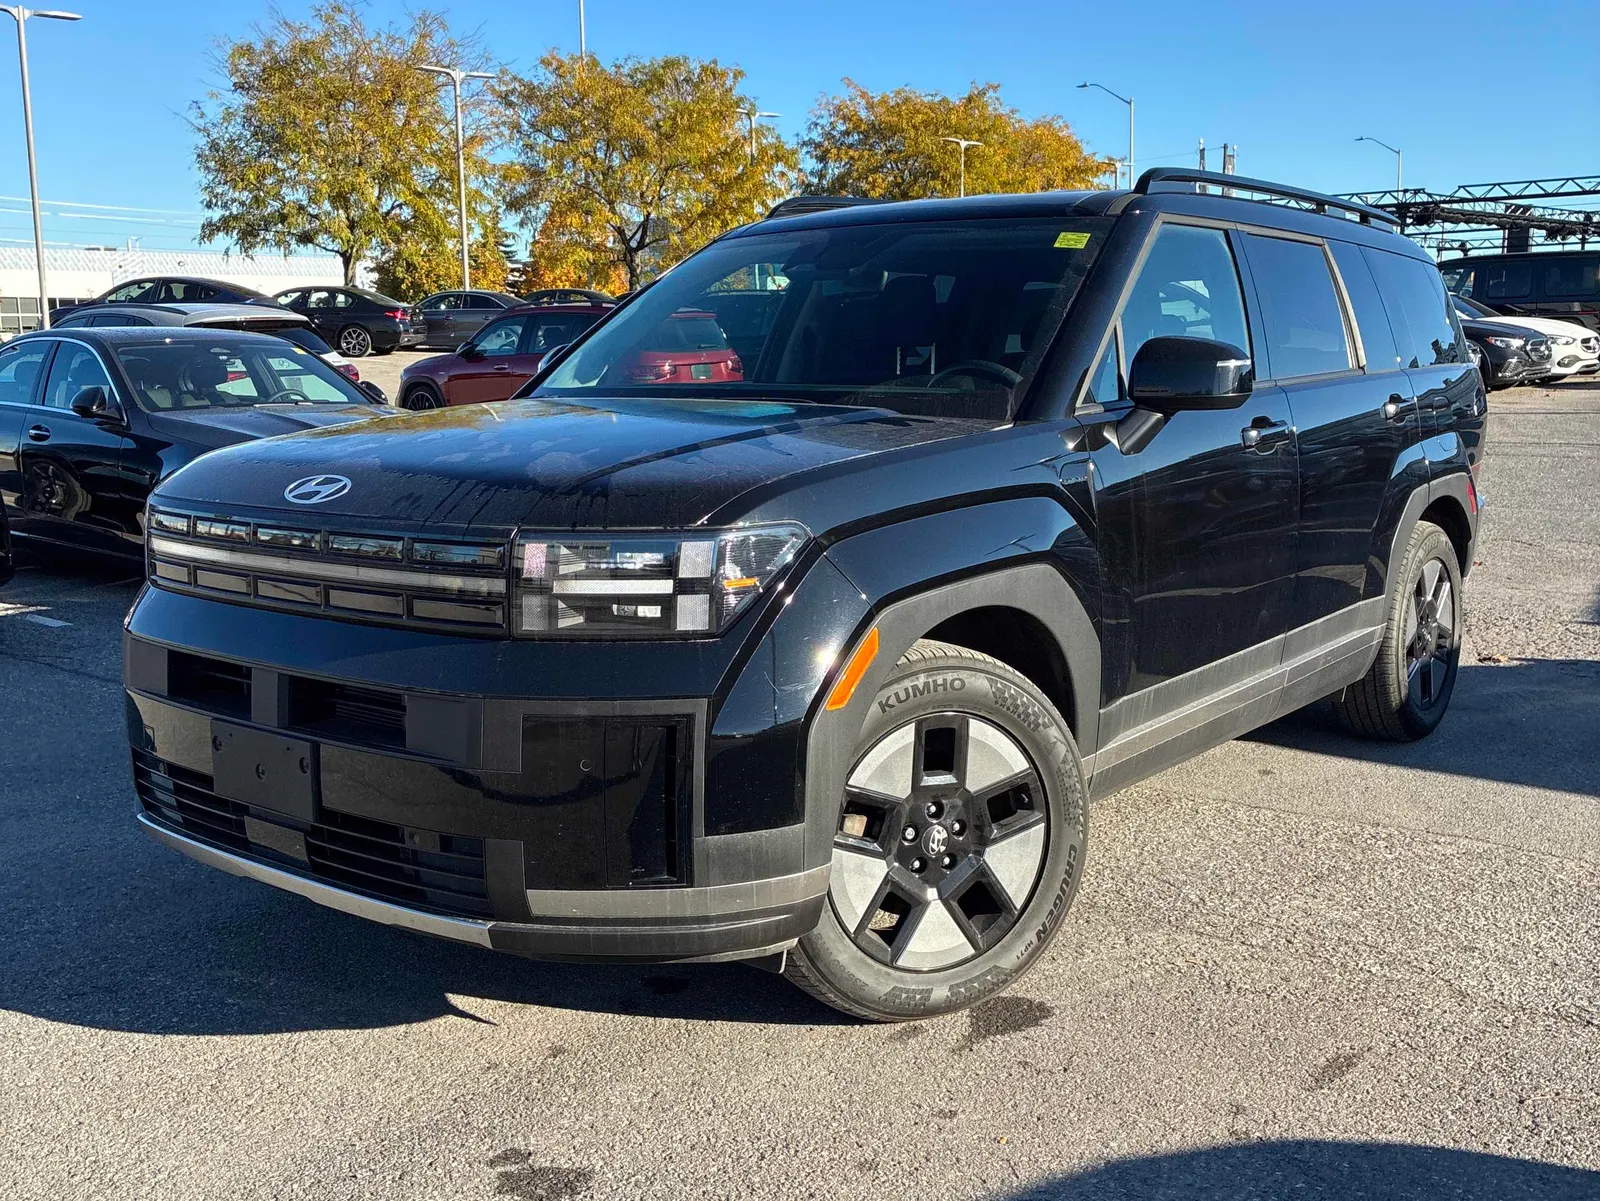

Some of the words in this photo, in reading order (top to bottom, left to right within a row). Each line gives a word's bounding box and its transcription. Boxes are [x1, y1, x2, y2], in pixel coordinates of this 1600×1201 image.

[877, 677, 967, 714] KUMHO
[1036, 843, 1078, 943] CRUGEN
[1016, 940, 1034, 961] HP71
